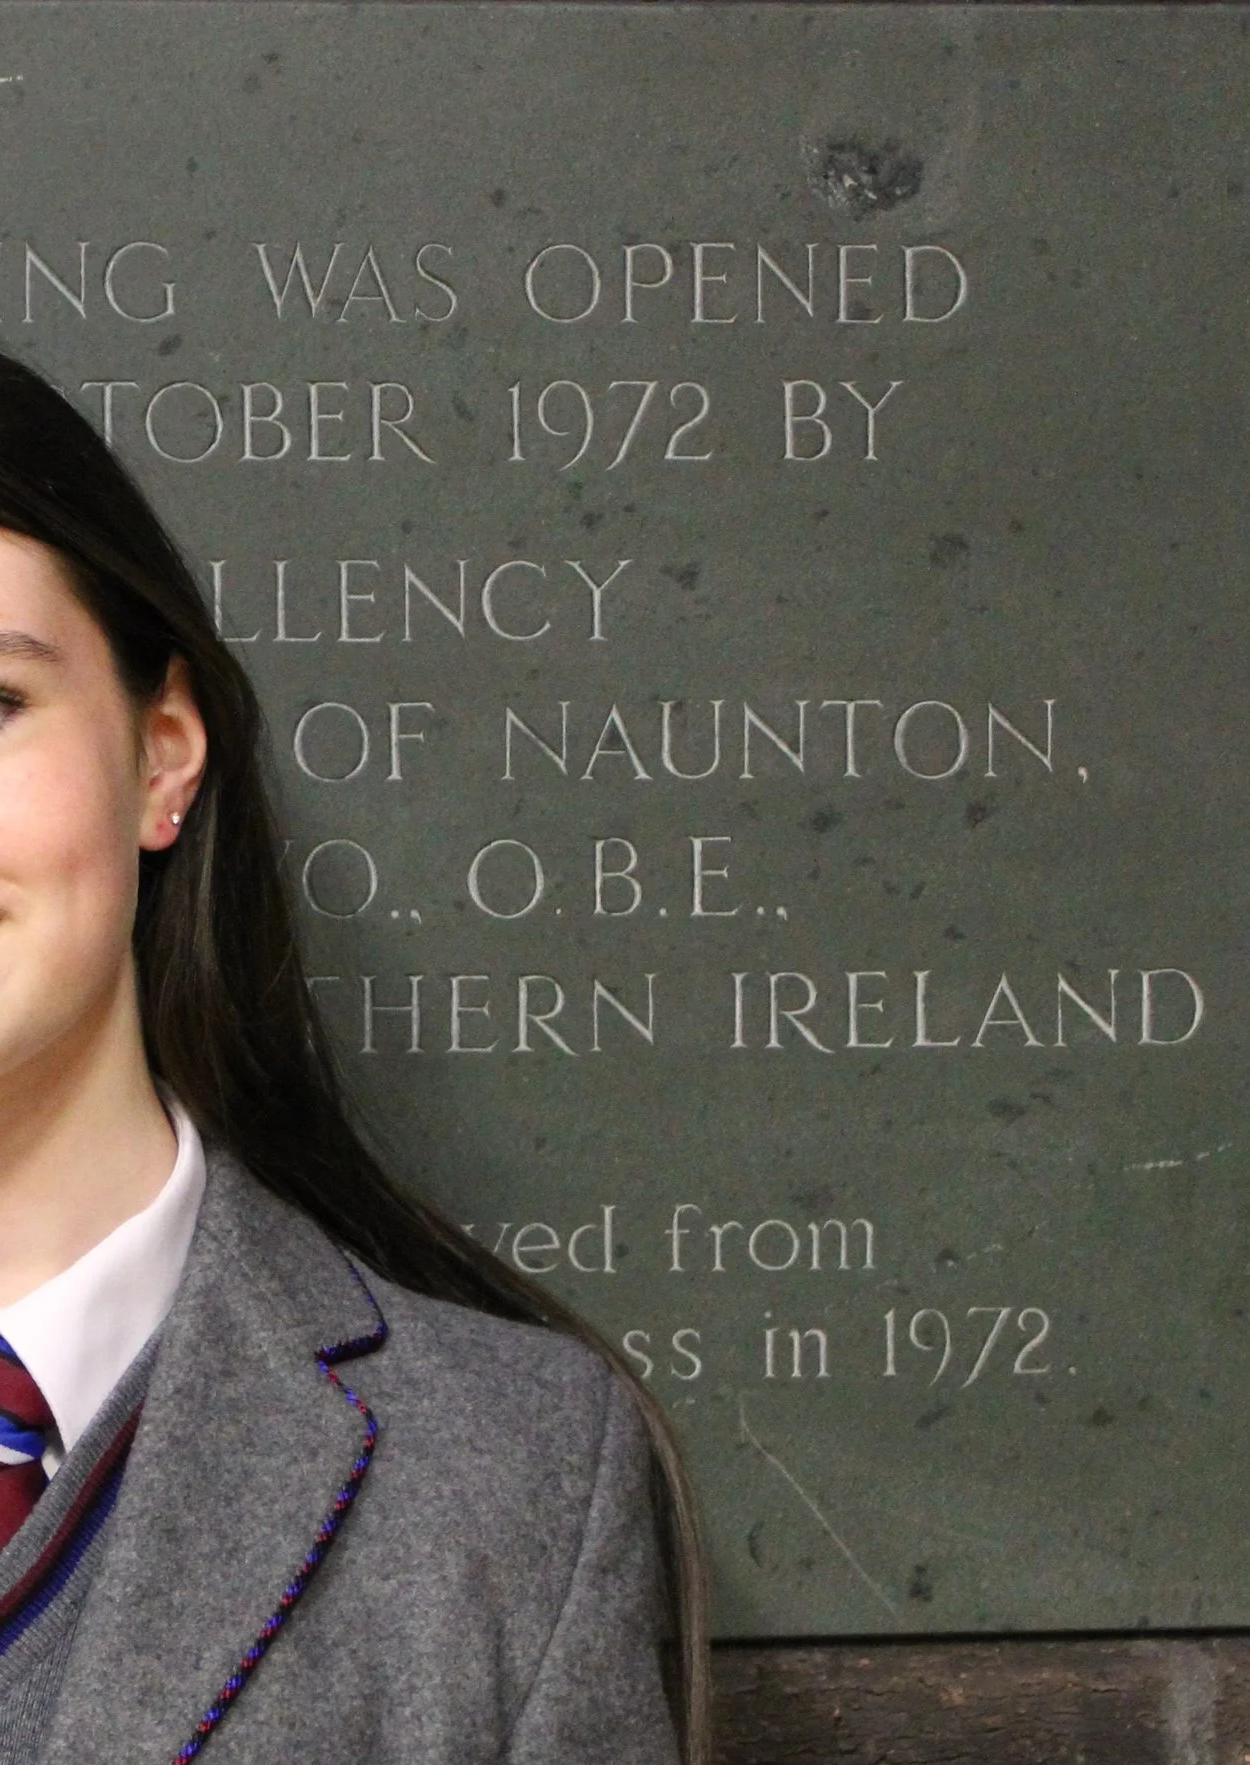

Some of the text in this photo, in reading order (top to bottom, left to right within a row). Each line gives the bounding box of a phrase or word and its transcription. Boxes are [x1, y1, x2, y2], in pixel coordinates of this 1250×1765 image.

[254, 242, 459, 324] WAS
[524, 242, 969, 325] OPENED
[51, 380, 437, 465] TOBER
[507, 379, 714, 471] 1972
[781, 379, 905, 463] BY
[209, 558, 634, 644] LLENCY
[293, 701, 435, 784] OF
[500, 698, 1090, 785] NAUNTON,
[729, 968, 1206, 1055] IRELAND
[664, 1203, 877, 1273] from
[763, 1310, 832, 1380] in
[881, 1305, 1078, 1389] 1972.
